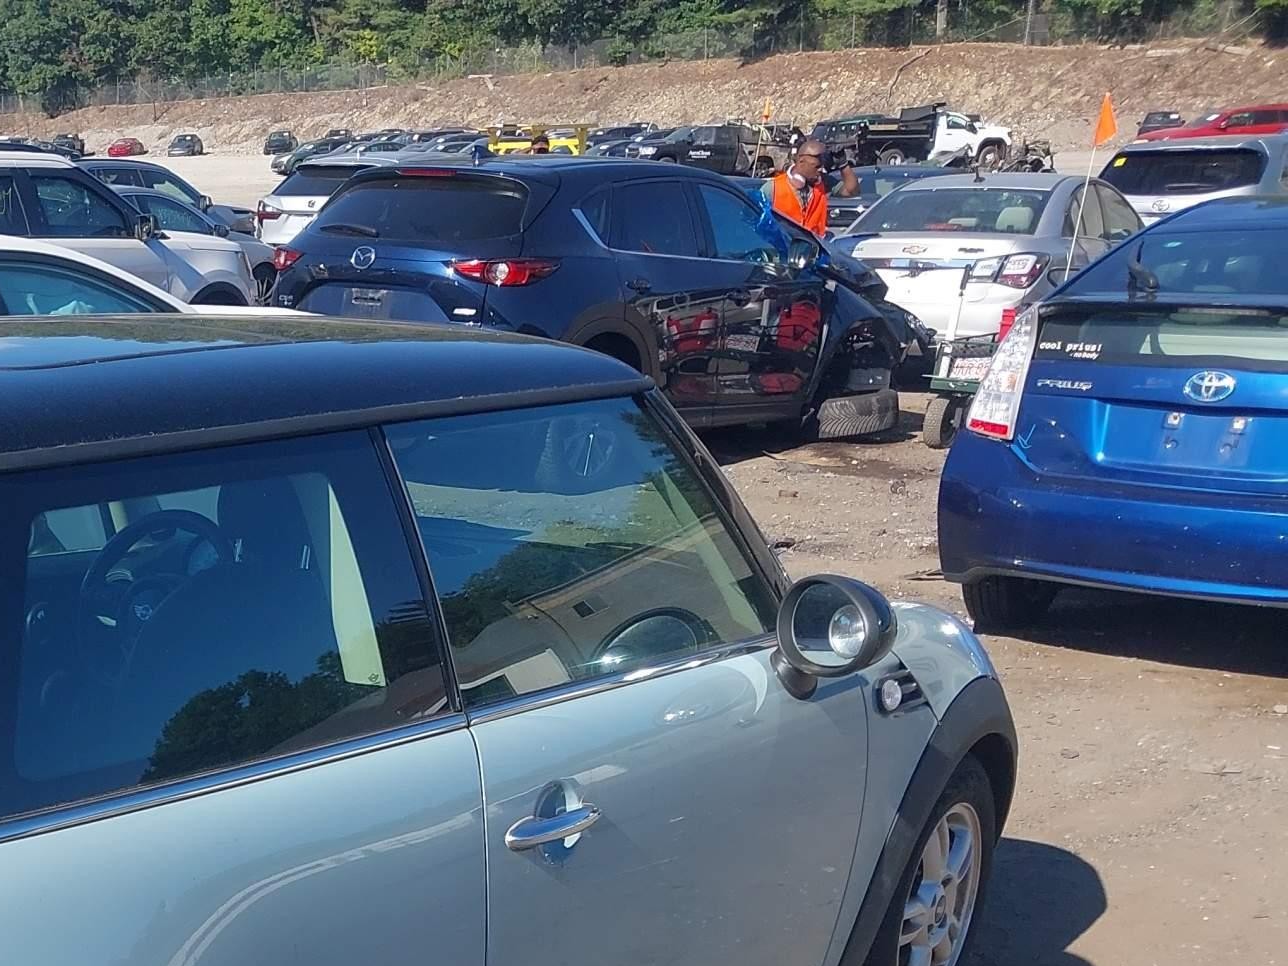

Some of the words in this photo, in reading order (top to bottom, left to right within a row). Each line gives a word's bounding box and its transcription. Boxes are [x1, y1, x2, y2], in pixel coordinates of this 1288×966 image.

[1039, 341, 1063, 350] cool
[1065, 342, 1103, 352] prius!
[1036, 379, 1093, 391] PRIUS
